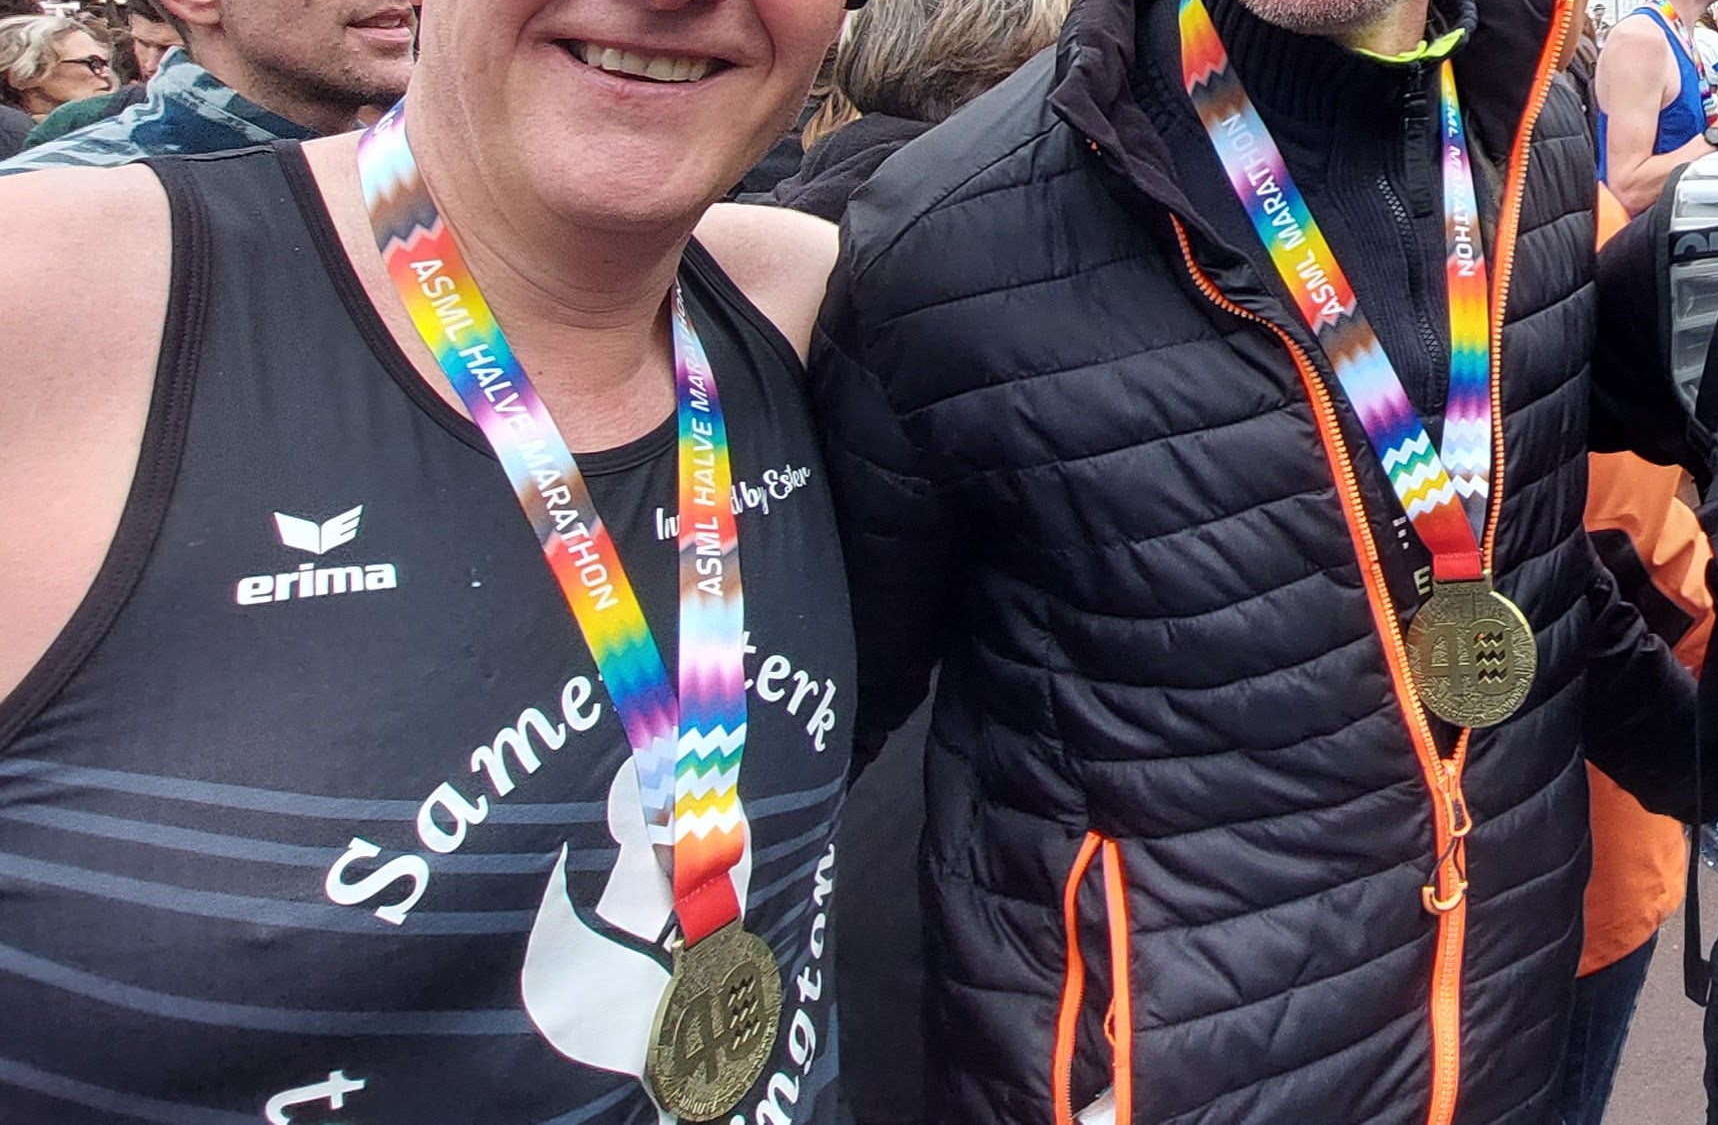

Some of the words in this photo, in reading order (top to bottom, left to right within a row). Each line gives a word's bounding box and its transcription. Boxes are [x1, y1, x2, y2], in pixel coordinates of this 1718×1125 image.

[1221, 112, 1307, 252] MARATHON
[1449, 145, 1476, 277] MARATHON
[1295, 248, 1345, 317] ASML
[409, 258, 474, 343] ASML
[458, 343, 535, 443] HALVE
[520, 437, 620, 613] MARATHON
[691, 417, 717, 507] HALVE
[739, 481, 770, 515] by
[762, 463, 811, 500] Ester
[236, 561, 397, 606] erima
[695, 515, 724, 597] ASML
[325, 674, 604, 926] Same
